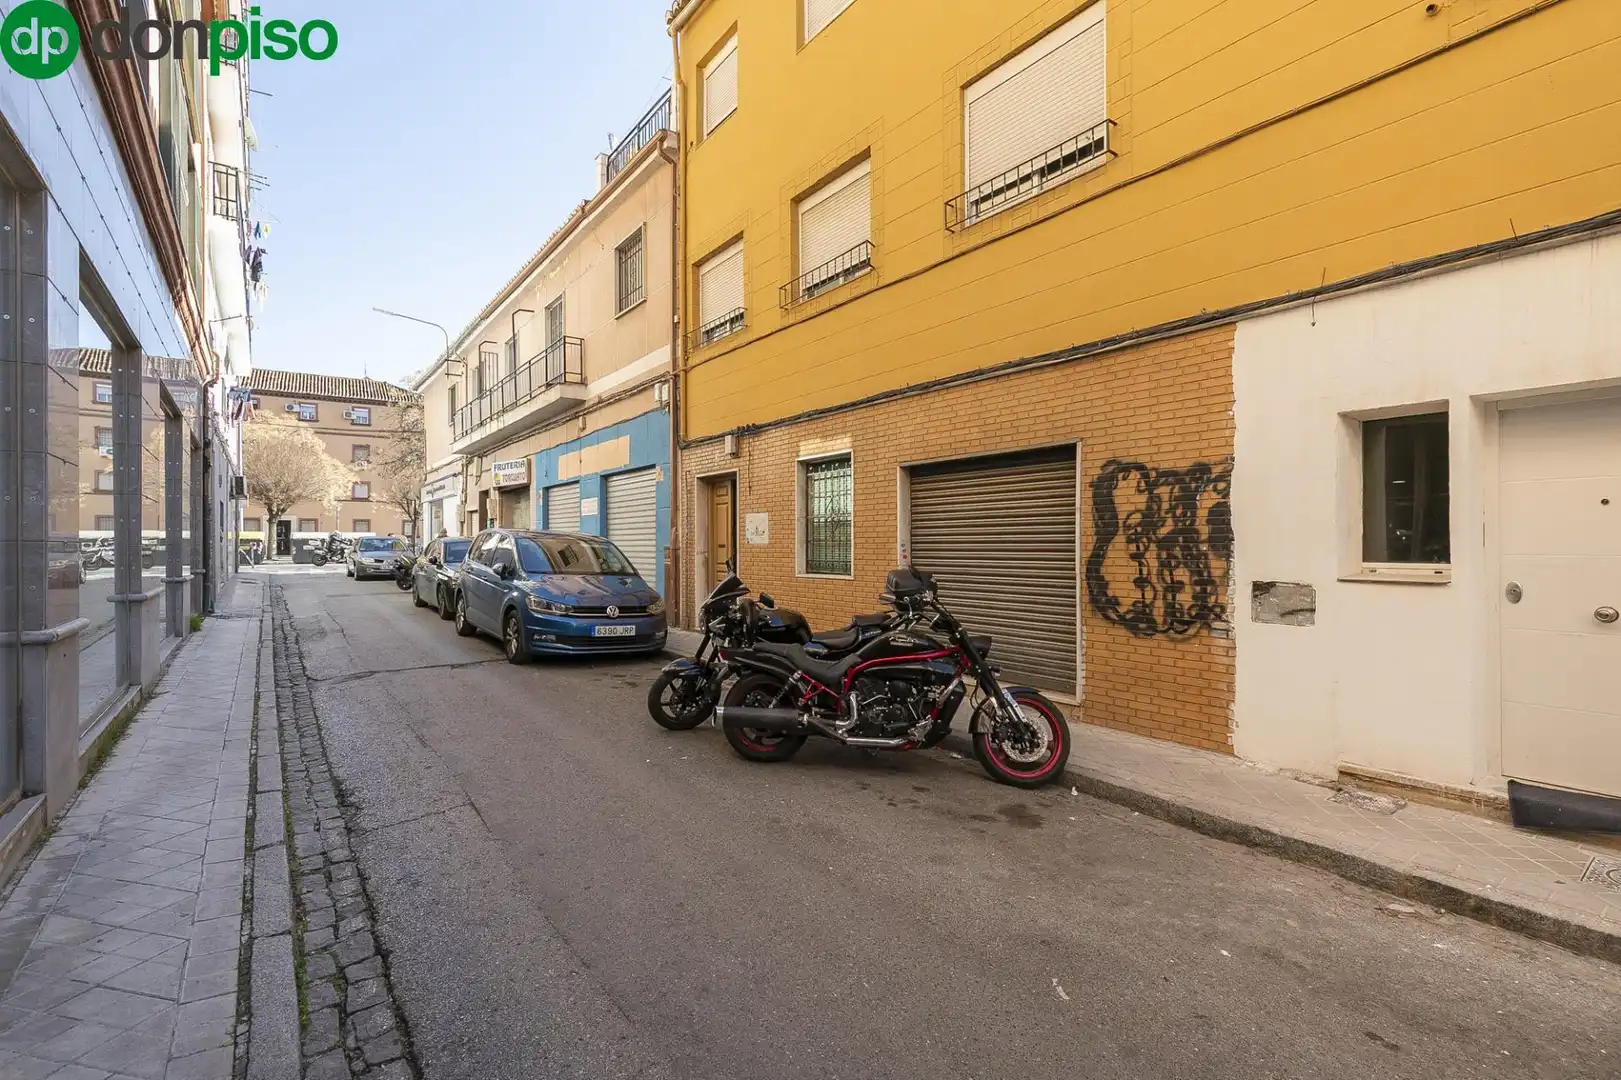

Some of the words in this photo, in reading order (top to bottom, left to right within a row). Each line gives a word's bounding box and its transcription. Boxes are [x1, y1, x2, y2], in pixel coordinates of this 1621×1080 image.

[493, 460, 525, 472] FRUTERIA
[597, 627, 618, 635] 6390
[620, 626, 634, 635] JRP
